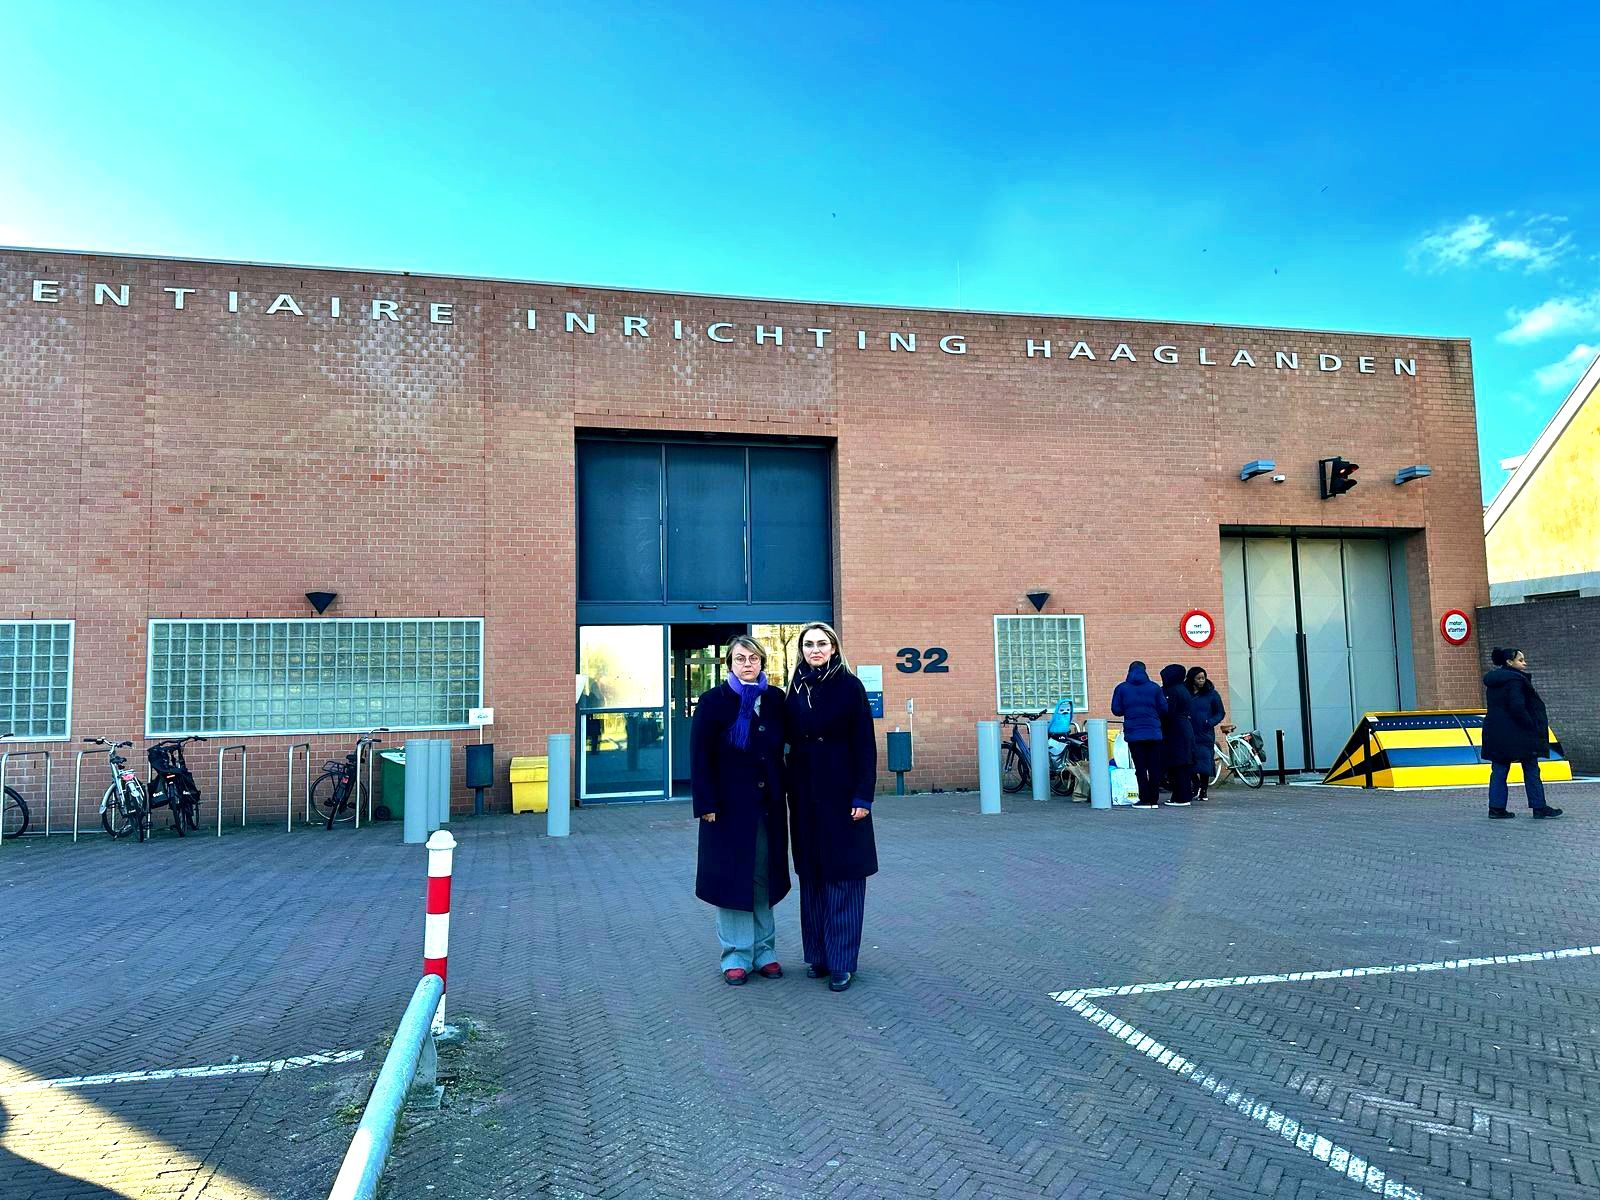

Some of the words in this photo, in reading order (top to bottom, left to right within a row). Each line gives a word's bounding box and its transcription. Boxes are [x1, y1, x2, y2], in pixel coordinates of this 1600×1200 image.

[32, 279, 454, 325] ENTIAIRE
[526, 309, 967, 355] INRICHTING
[1026, 339, 1417, 376] HAAGLANDEN
[895, 647, 949, 673] 32
